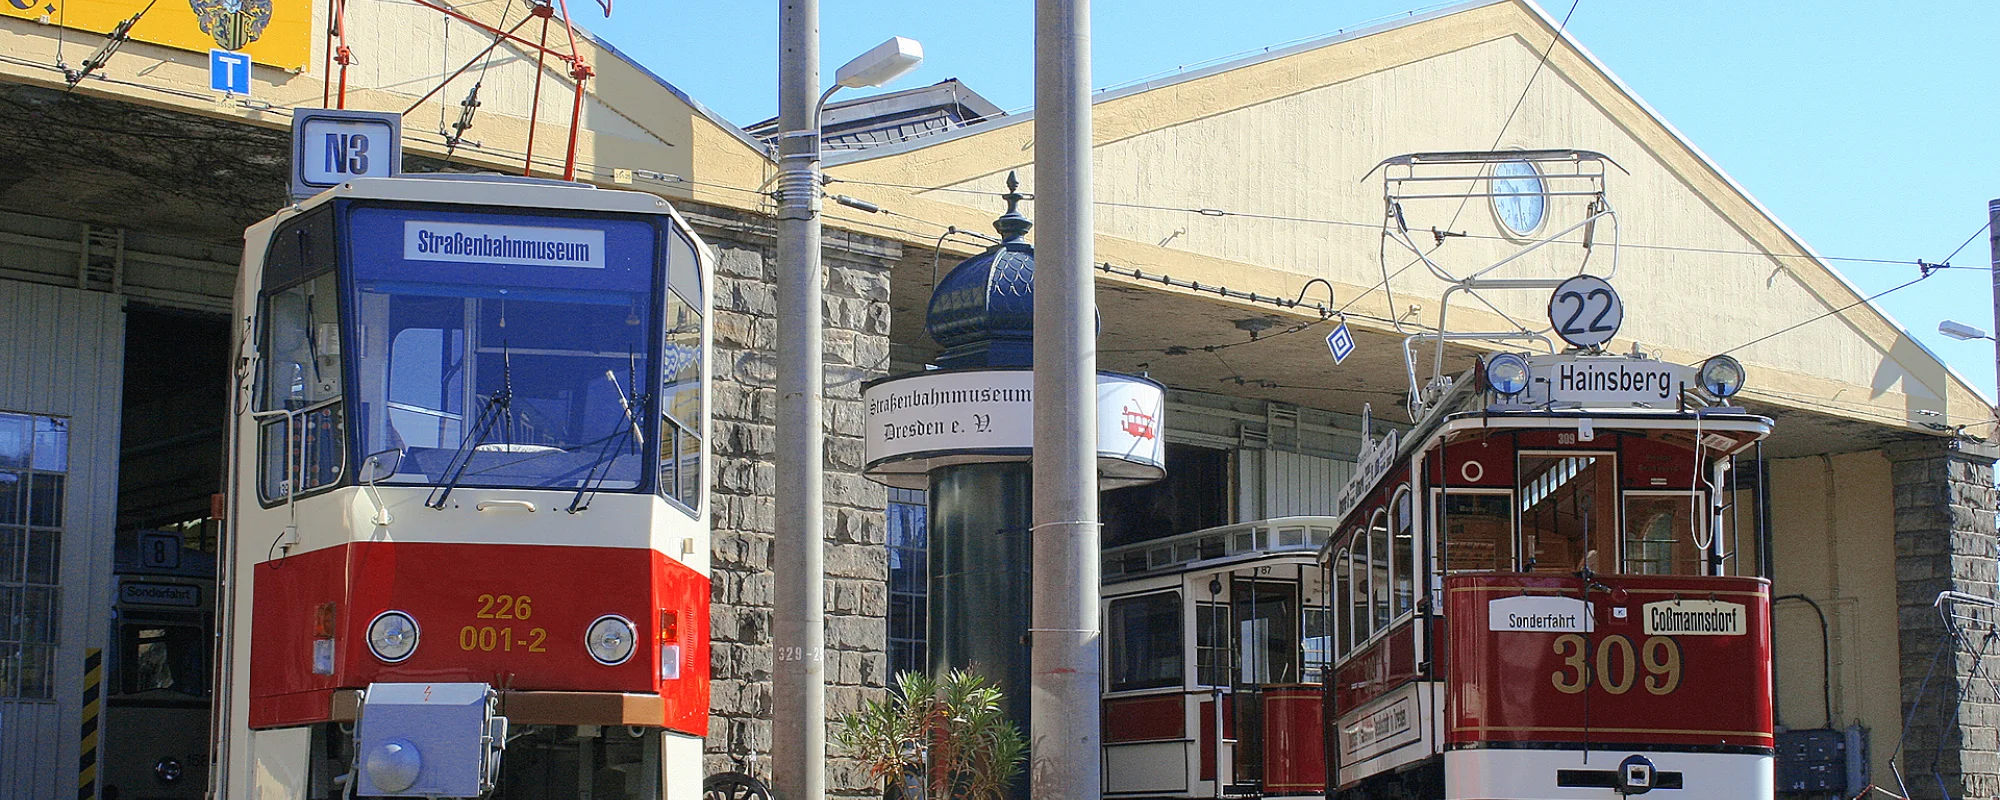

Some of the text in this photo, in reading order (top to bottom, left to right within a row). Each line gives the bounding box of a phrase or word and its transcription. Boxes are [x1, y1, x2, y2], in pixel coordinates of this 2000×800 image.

[218, 56, 242, 88] T
[325, 133, 369, 175] N3
[418, 230, 590, 262] Straßenbahnmuseum
[1559, 288, 1613, 335] 22
[1560, 364, 1671, 399] Hainsberg
[870, 386, 1032, 416] Straßenbahnmuseum
[884, 413, 992, 443] Dresden e. V.
[1558, 433, 1575, 445] 309
[155, 540, 165, 563] 8
[1261, 565, 1272, 575] 87
[127, 585, 191, 600] Sonderfahrt
[476, 593, 532, 620] 226
[1509, 613, 1576, 629] Sonderfahrt
[1651, 606, 1737, 633] Coßmannsdorf
[459, 625, 547, 653] 001-2
[1551, 634, 1681, 695] 309
